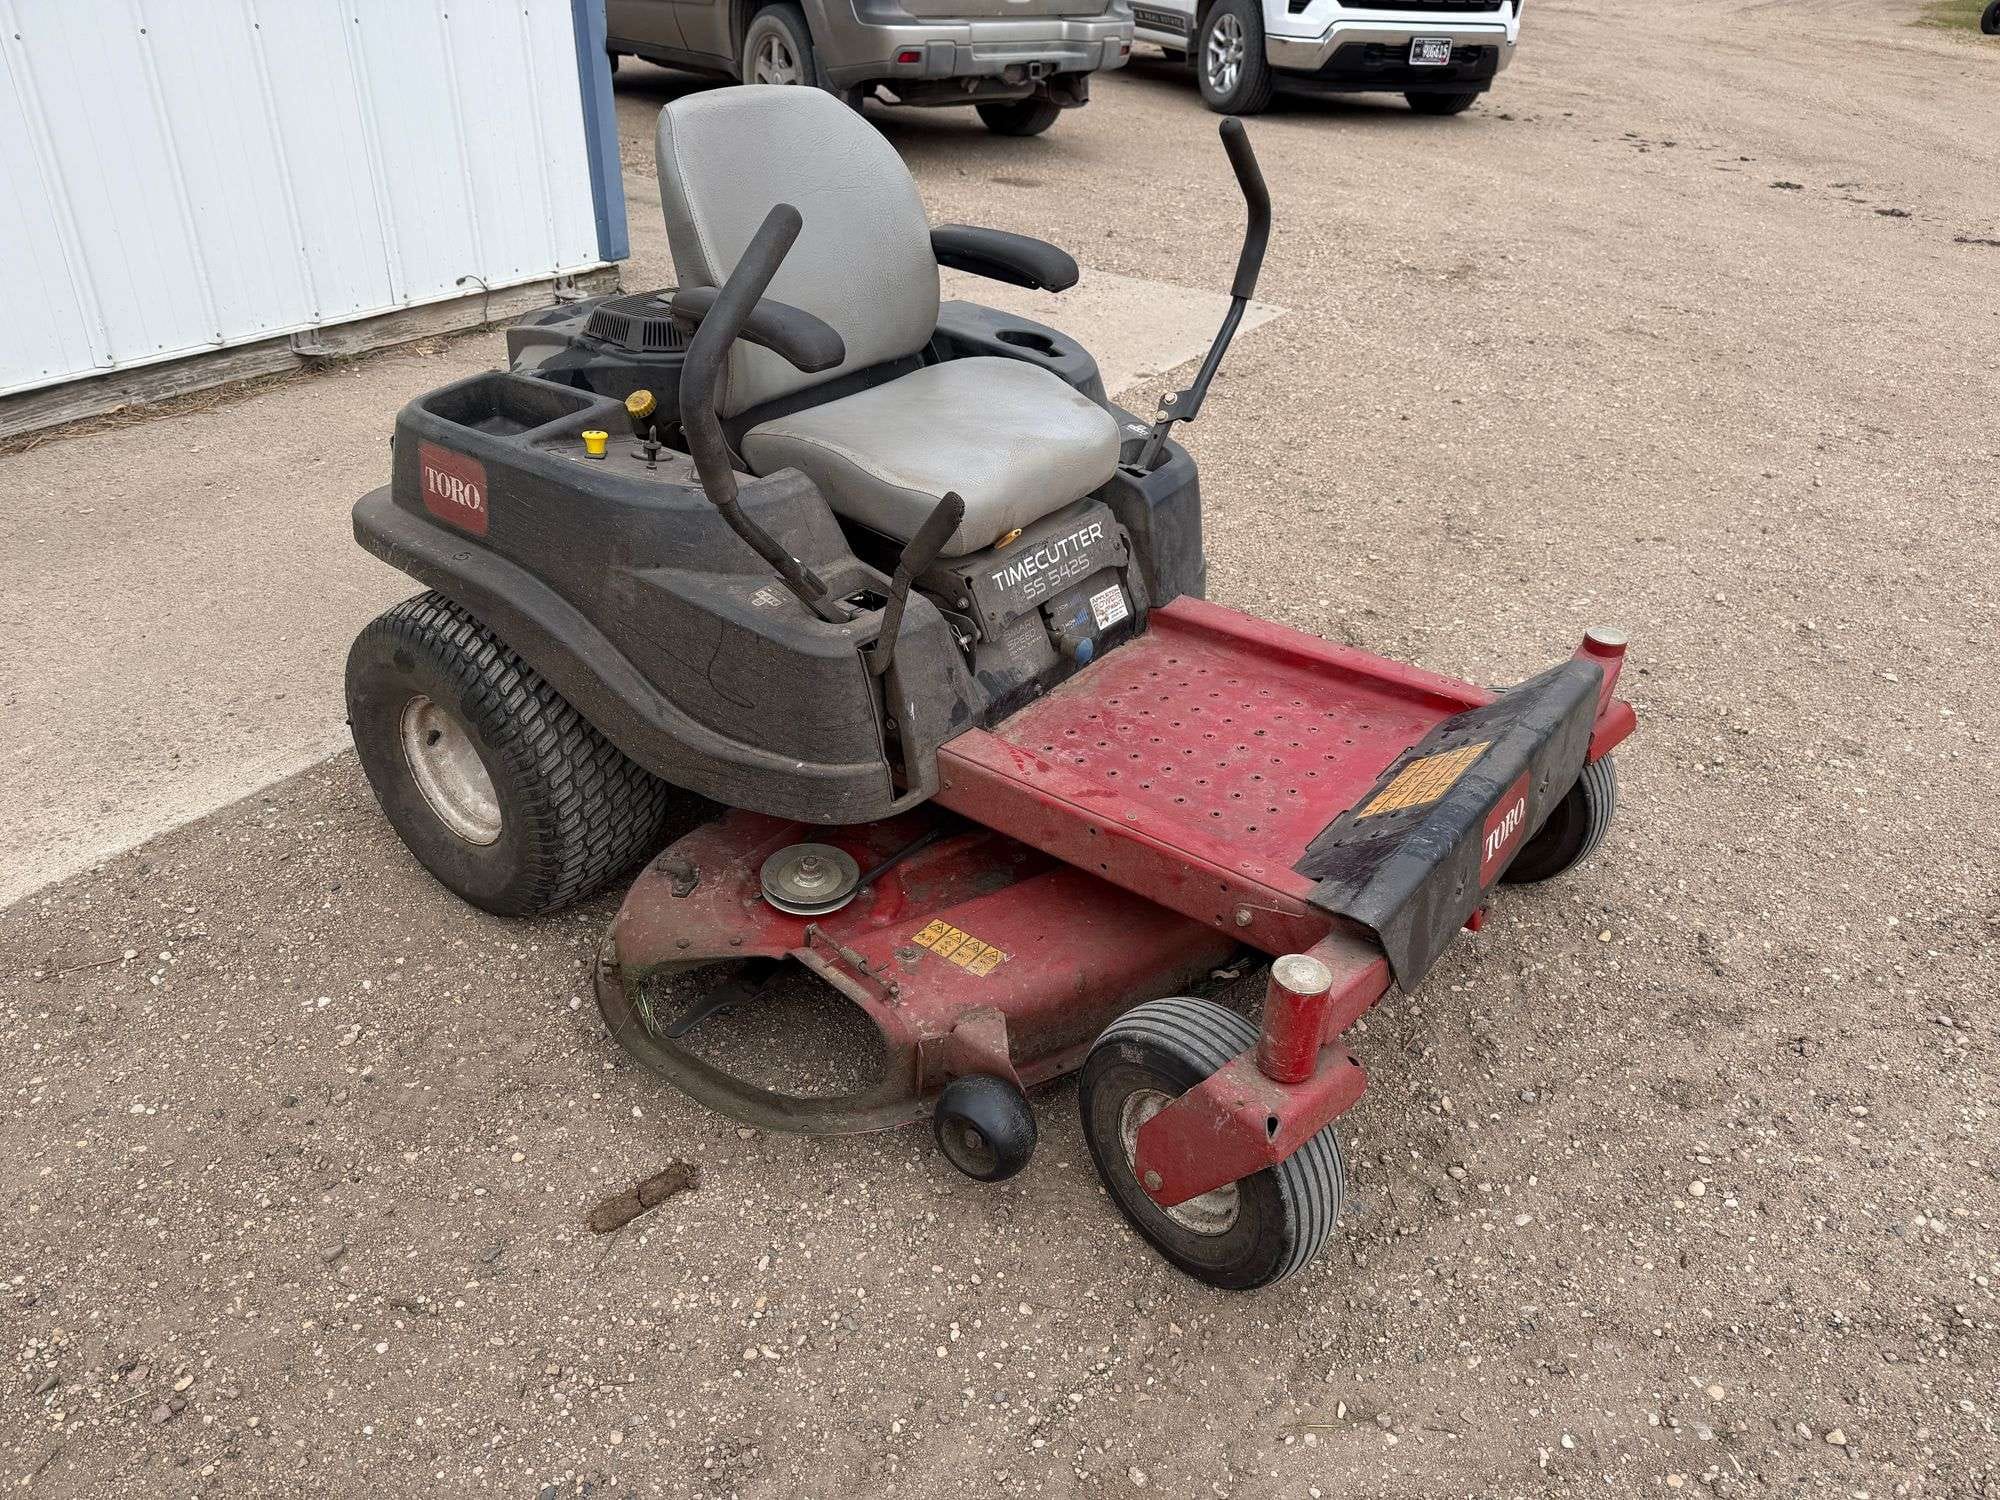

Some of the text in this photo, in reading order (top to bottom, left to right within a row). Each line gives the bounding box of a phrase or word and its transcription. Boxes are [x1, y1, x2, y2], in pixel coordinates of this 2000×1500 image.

[992, 522, 1103, 591] TIMECUTTER
[1024, 553, 1090, 600] SS 5425
[1485, 797, 1525, 863] TORO
